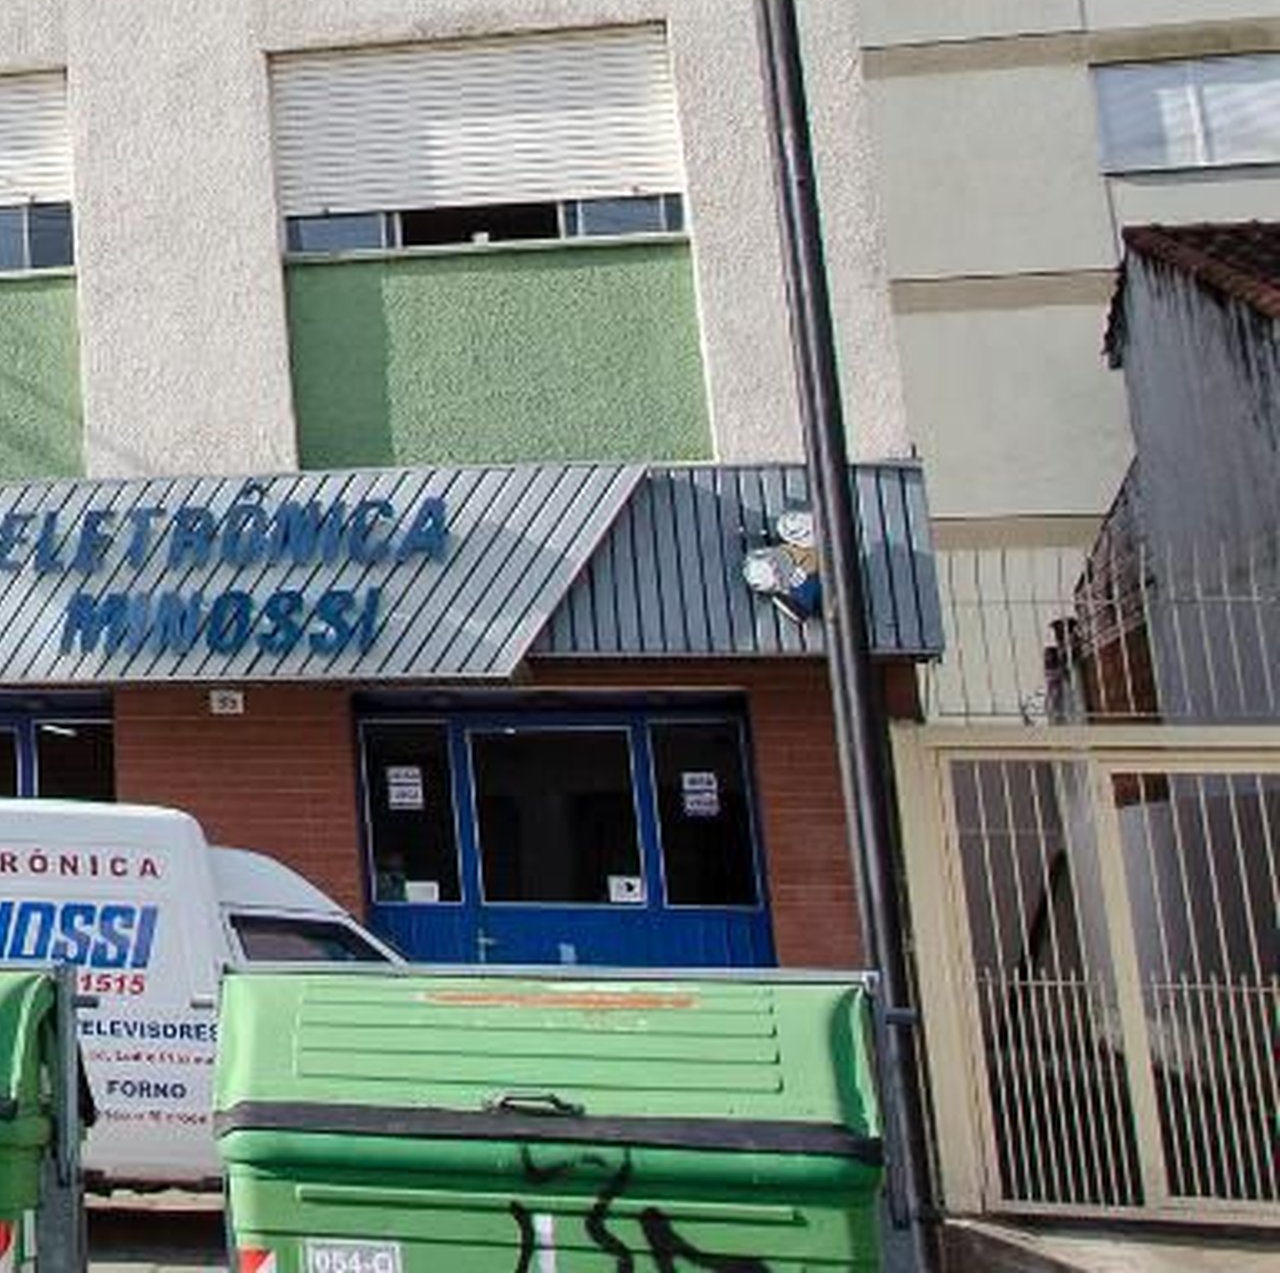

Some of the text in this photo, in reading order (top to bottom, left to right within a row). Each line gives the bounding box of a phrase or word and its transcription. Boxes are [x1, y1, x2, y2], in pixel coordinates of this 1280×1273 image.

[58, 586, 381, 656] MINOSSI
[77, 1018, 218, 1044] ELEVISORES
[106, 1080, 188, 1100] FORNO
